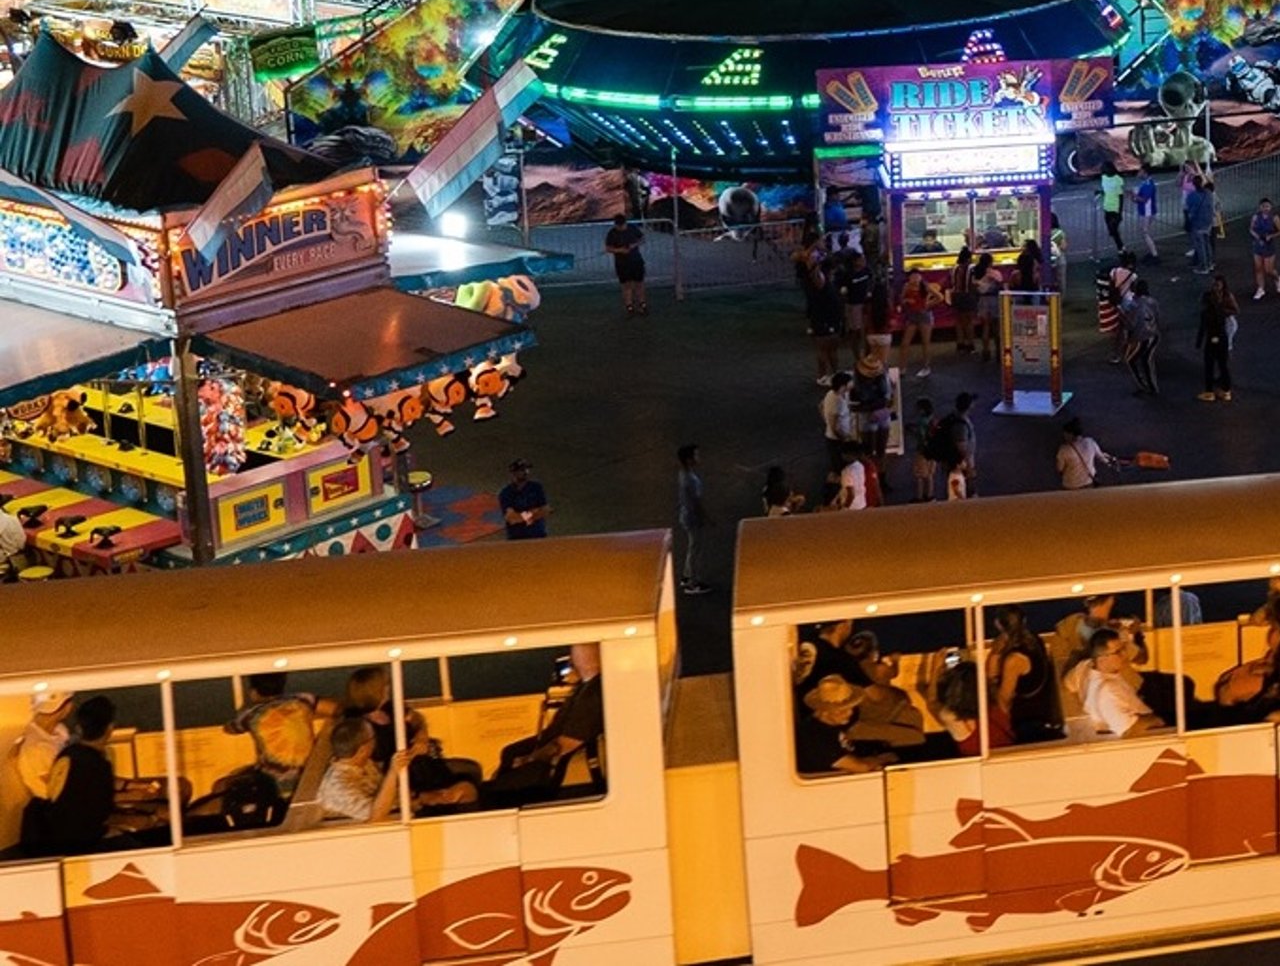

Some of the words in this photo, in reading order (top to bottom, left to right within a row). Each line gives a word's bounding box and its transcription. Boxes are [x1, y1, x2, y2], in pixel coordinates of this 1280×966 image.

[266, 50, 305, 66] CORN
[891, 78, 993, 110] RIDE
[891, 105, 1047, 141] TICKETS
[182, 208, 328, 292] WINNER
[273, 248, 306, 272] EVERY
